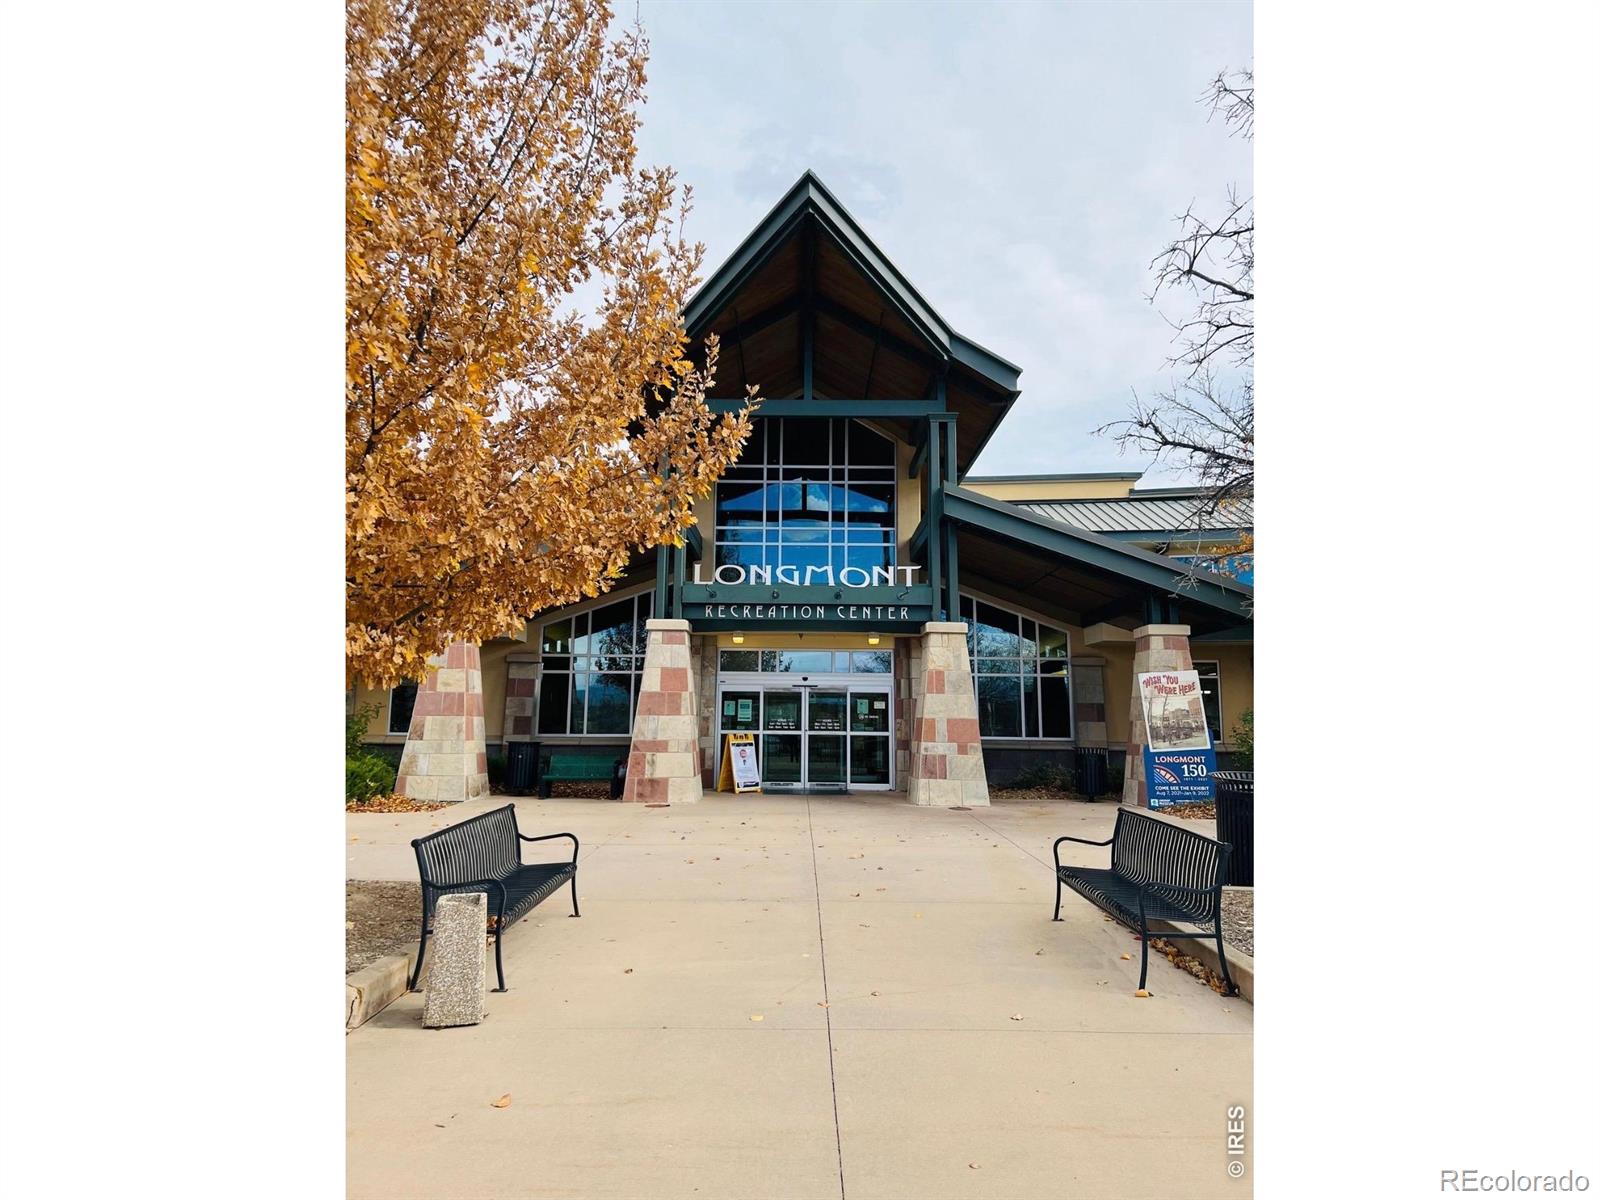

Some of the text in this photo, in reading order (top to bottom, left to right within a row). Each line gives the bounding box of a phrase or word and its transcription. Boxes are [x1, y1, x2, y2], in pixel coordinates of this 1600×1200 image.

[694, 564, 922, 588] LONGMONT
[705, 605, 909, 620] RECREATION CENTER
[1143, 675, 1179, 688] WISH YOU
[1154, 681, 1196, 696] WERE HERE
[1181, 764, 1207, 777] 150
